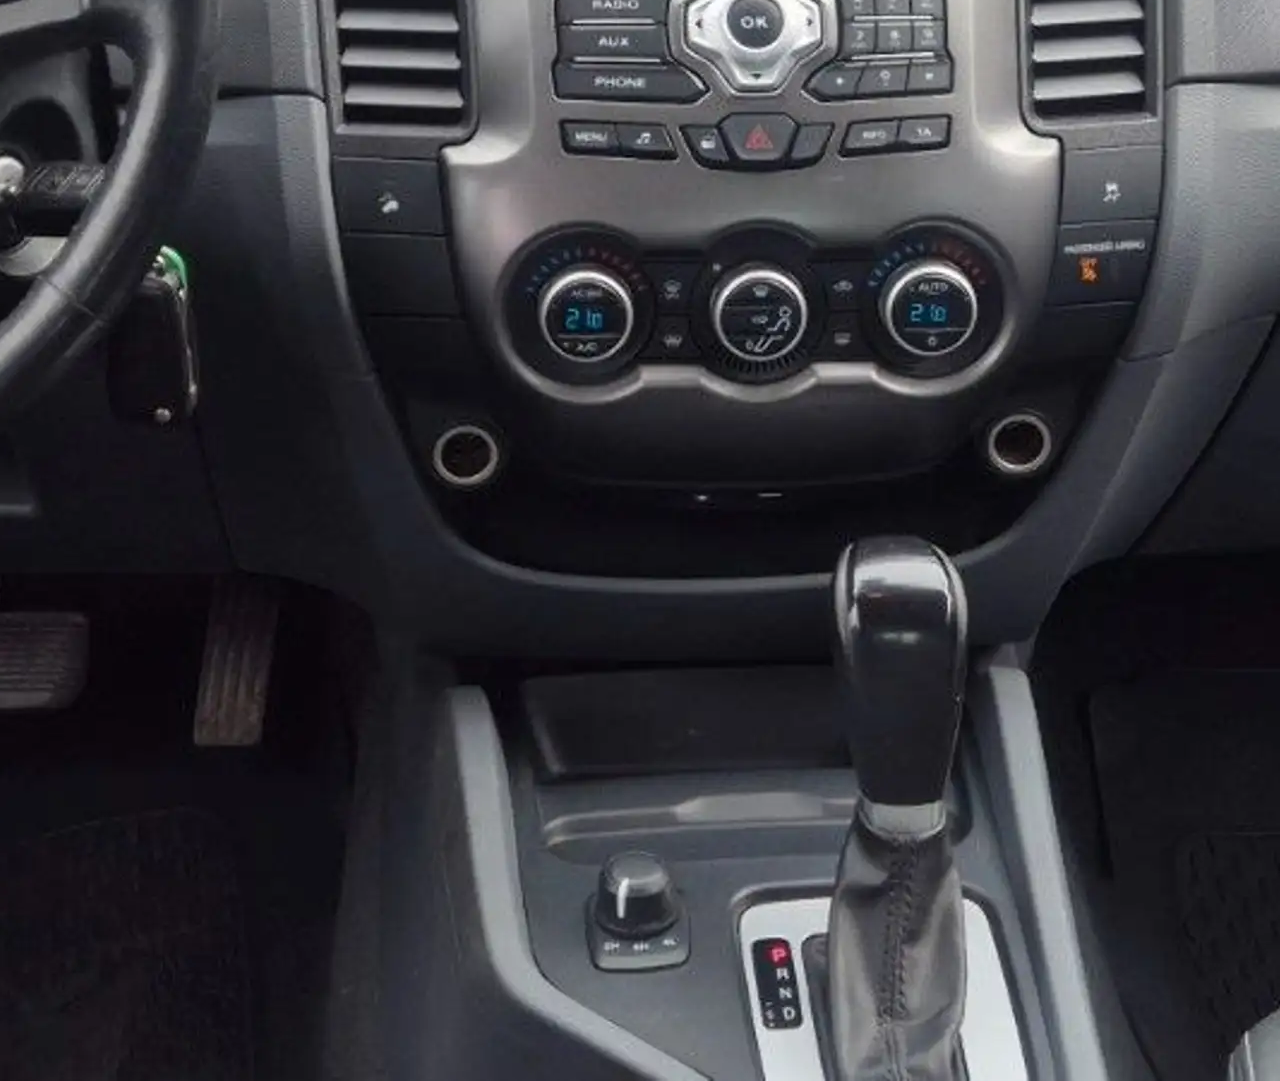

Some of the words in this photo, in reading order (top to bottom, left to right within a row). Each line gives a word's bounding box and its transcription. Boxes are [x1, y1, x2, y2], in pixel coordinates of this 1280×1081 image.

[592, 0, 640, 11] RADIO
[740, 15, 770, 30] OK
[598, 36, 630, 47] AUX
[593, 75, 646, 89] PHONE
[772, 948, 787, 963] P
[776, 968, 790, 980] R
[779, 987, 793, 999] N
[783, 1006, 796, 1021] D
